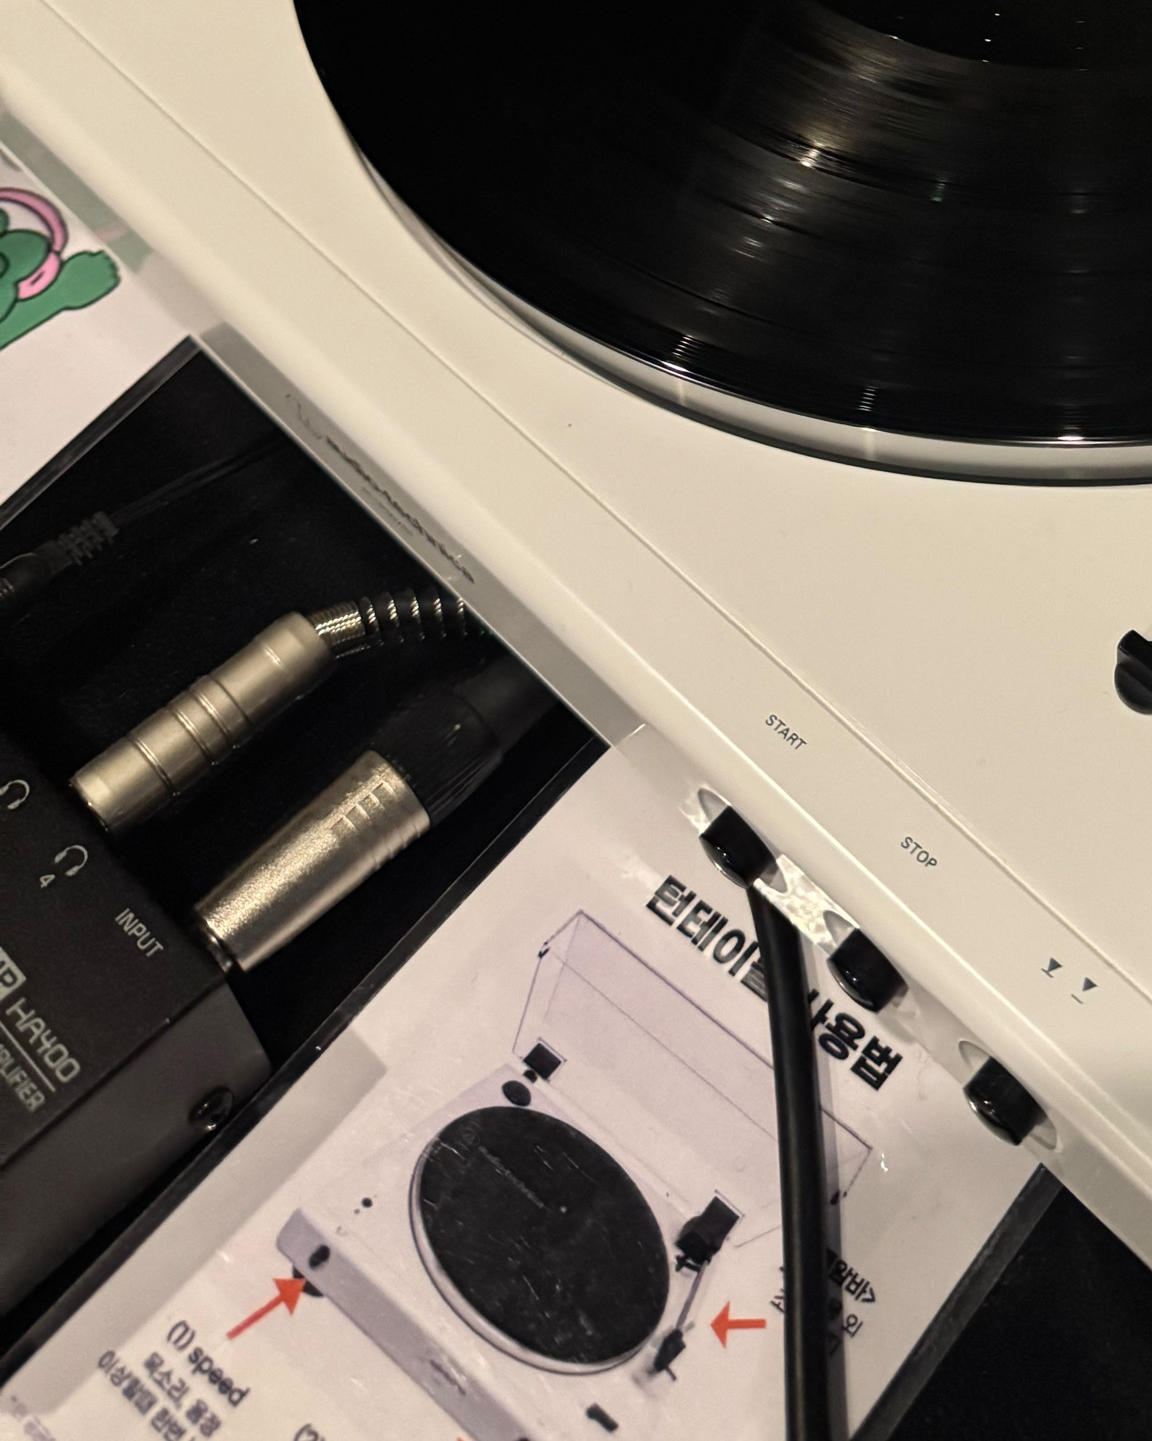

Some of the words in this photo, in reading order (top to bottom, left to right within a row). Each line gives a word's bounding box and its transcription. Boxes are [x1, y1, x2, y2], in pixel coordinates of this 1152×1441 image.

[765, 714, 807, 750] START
[900, 836, 938, 868] STOP
[39, 874, 56, 888] 4
[115, 908, 164, 957] INPUT
[5, 997, 81, 1083] HA400
[0, 1043, 45, 1113] PLIFIER
[166, 1320, 195, 1351] (1)
[188, 1346, 250, 1407] speed
